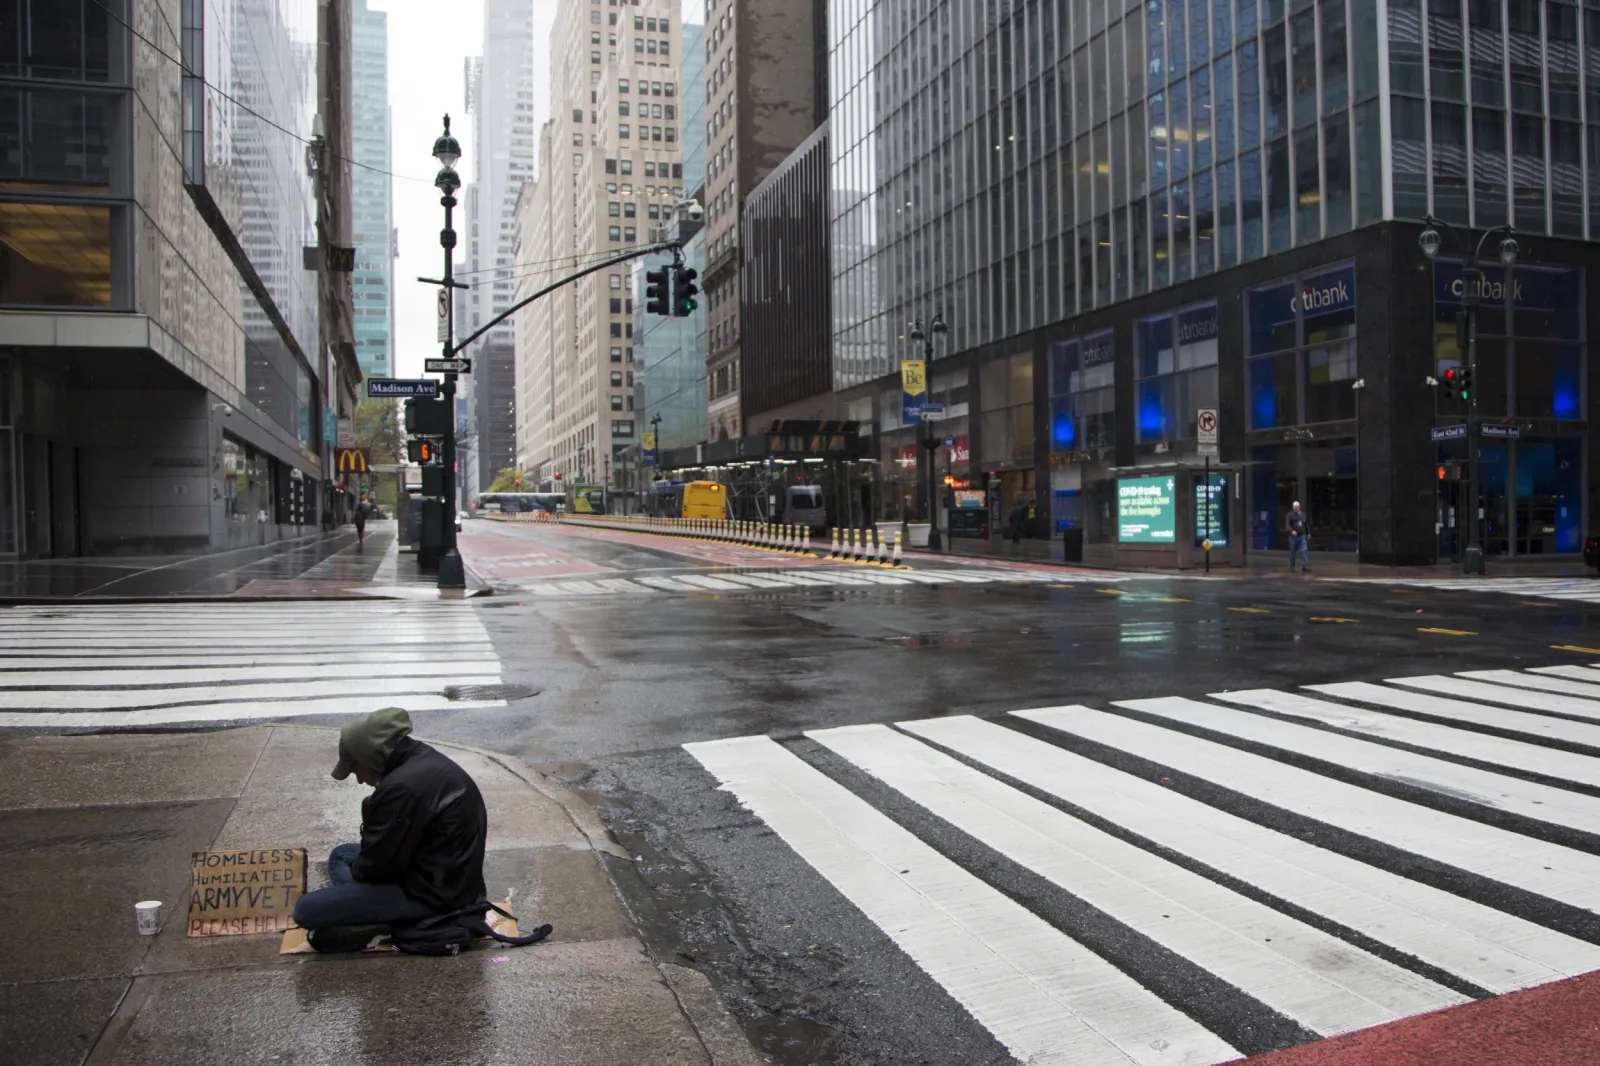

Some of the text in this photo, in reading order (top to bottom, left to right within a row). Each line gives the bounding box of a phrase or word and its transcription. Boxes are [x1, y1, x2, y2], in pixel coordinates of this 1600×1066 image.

[1290, 280, 1349, 313] ctibank
[1452, 276, 1522, 301] cibak
[1179, 314, 1217, 340] itibank
[371, 383, 435, 393] Madison Ave
[1433, 426, 1465, 438] East 42nd St
[1482, 426, 1519, 436] Madison Ave
[421, 444, 429, 460] 6
[193, 849, 293, 867] HOMELESS
[190, 917, 252, 935] PLEASE
